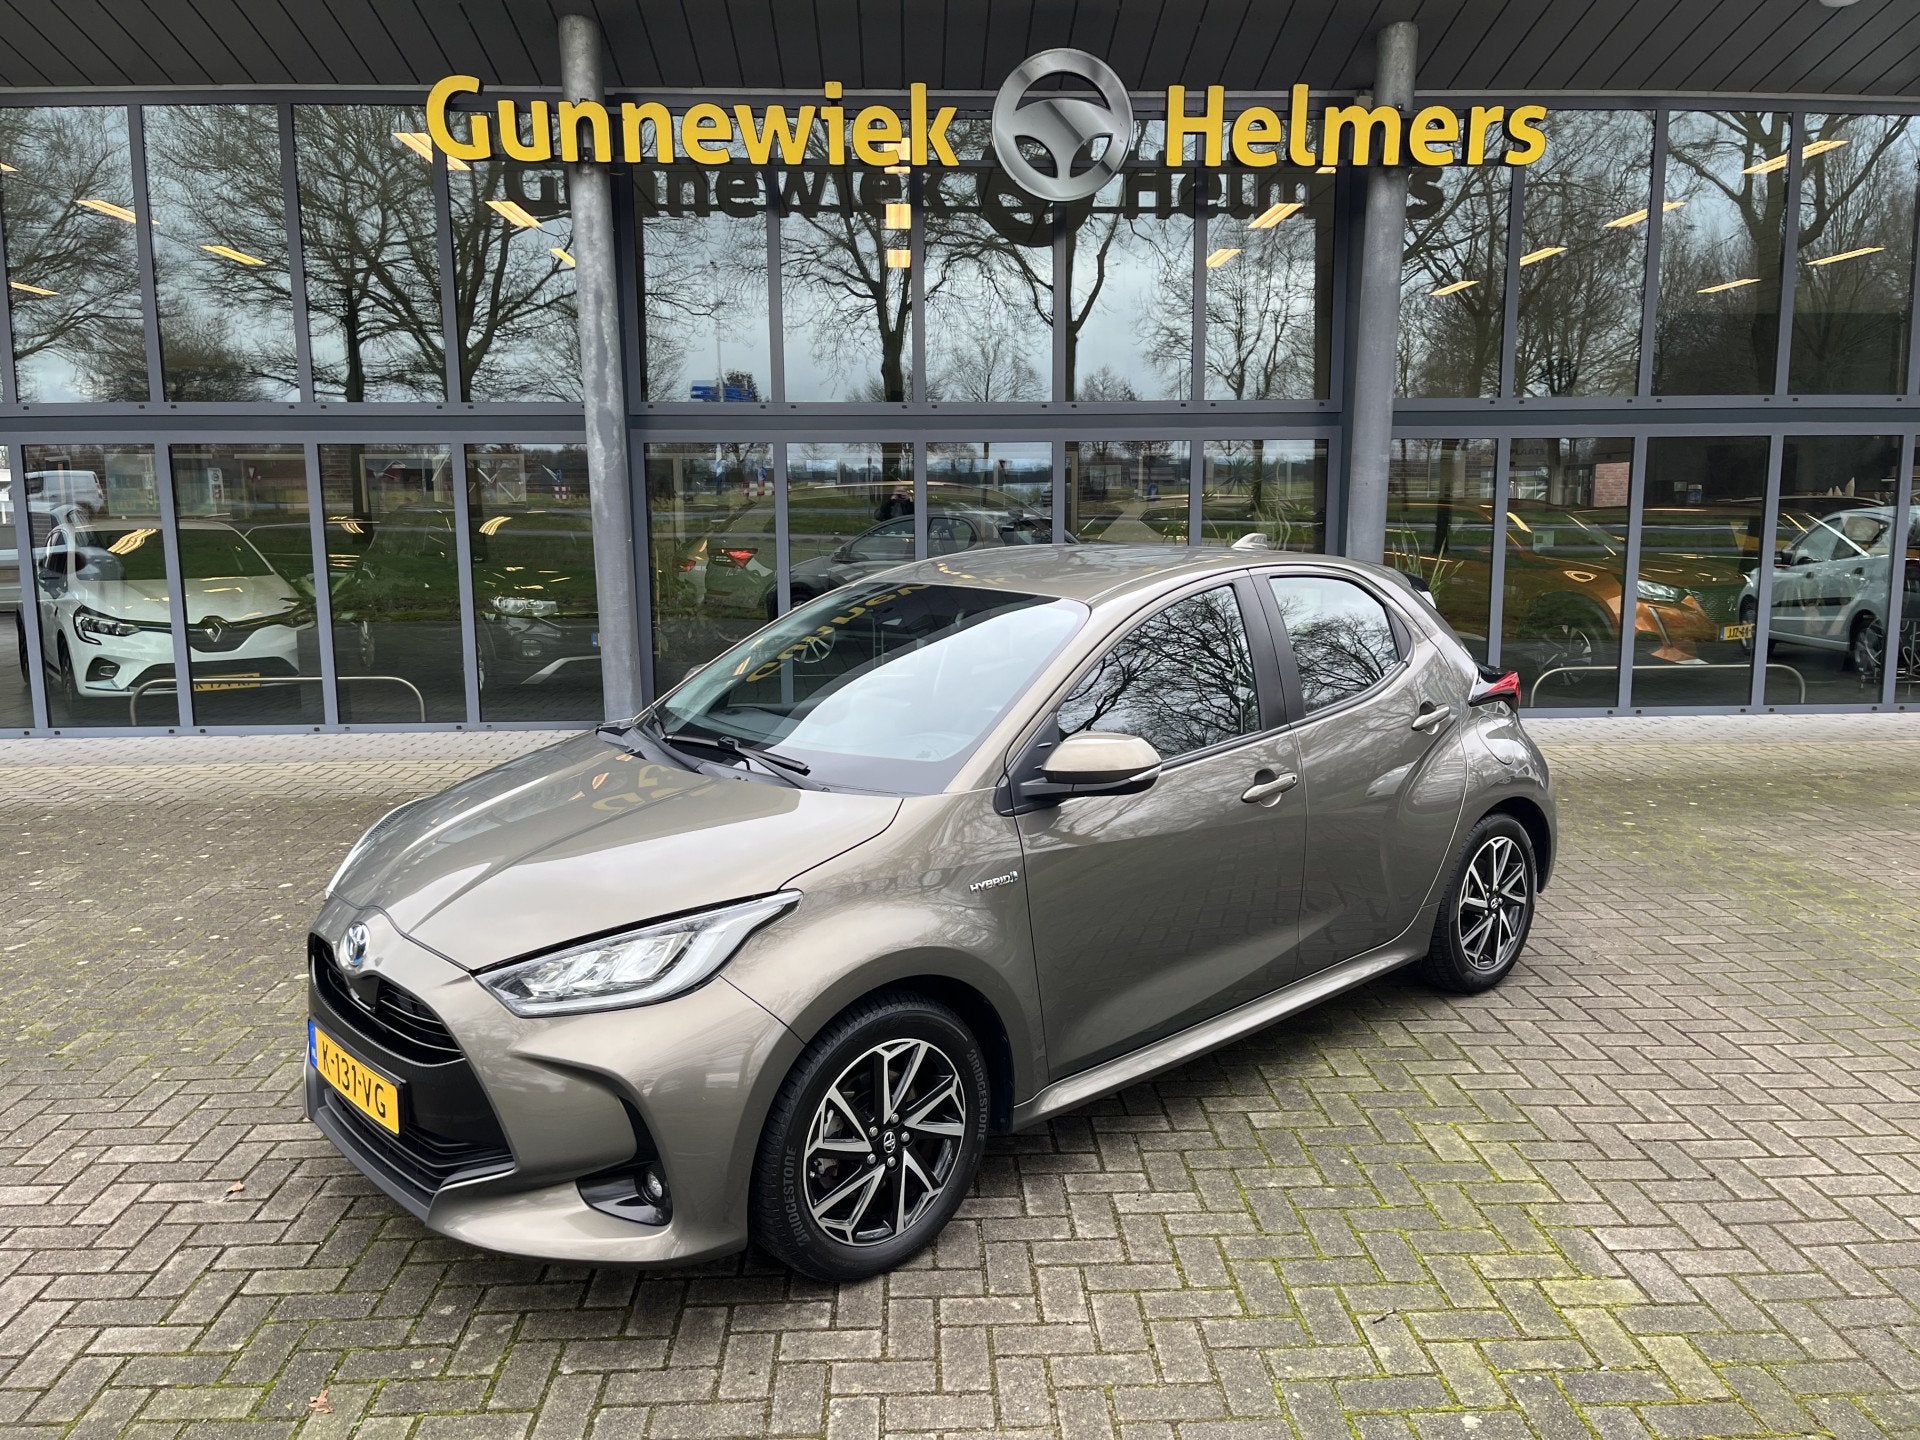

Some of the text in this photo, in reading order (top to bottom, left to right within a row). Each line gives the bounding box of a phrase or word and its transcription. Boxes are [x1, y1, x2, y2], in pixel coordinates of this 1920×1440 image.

[425, 74, 1548, 168] Gunnewiek Helmers
[969, 873, 1012, 894] HYBRID
[322, 1040, 387, 1118] K-131-VG
[967, 1048, 989, 1142] BRIDGESTONE
[783, 1145, 811, 1247] BRIDGESTONE
